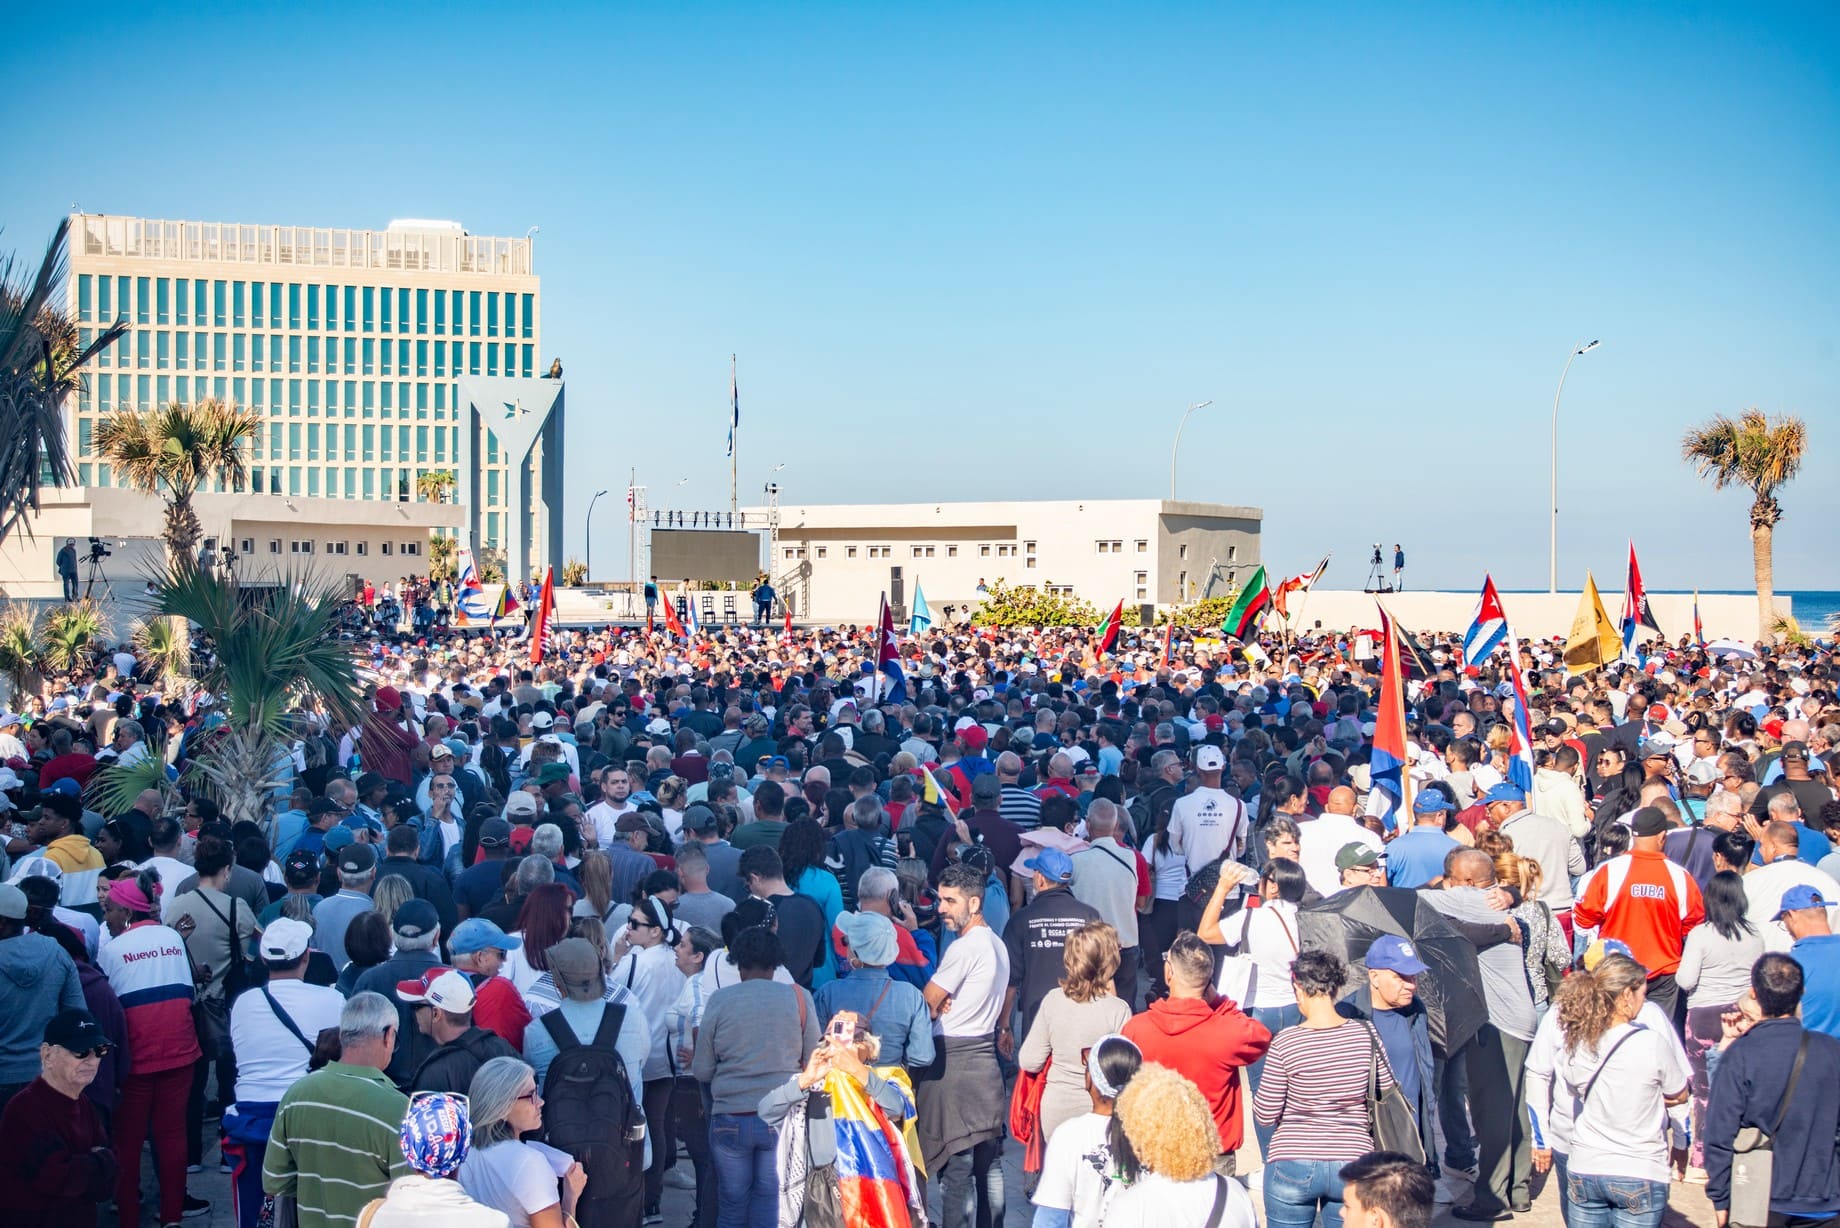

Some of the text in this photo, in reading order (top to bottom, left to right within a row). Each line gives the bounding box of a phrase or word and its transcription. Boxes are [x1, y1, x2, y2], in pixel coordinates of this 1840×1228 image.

[1631, 884, 1664, 900] CUBA
[123, 946, 182, 964] Nuevo León
